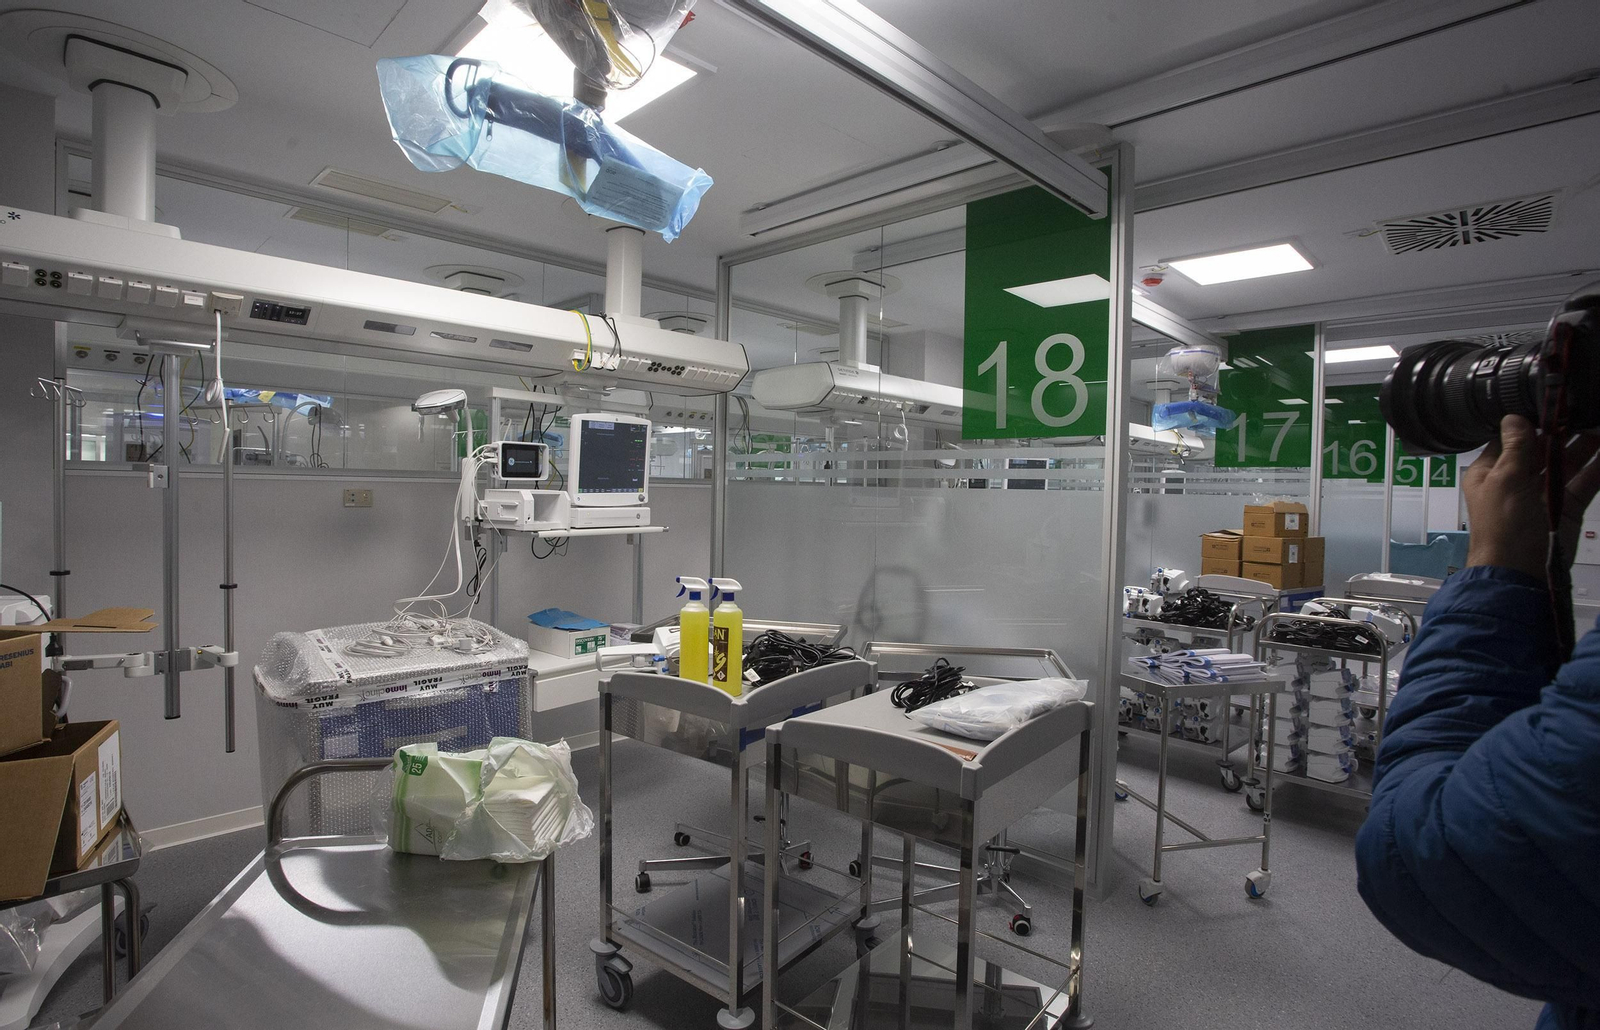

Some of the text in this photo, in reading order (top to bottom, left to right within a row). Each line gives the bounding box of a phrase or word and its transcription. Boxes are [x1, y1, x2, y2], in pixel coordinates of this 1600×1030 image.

[977, 333, 1089, 429] 18
[1226, 411, 1300, 462] 17
[1323, 439, 1377, 476] 16
[413, 676, 443, 686] FRAGIL
[420, 684, 438, 692] MUY
[305, 693, 340, 704] FRAGIL
[312, 701, 334, 710] MUY
[412, 762, 422, 774] 25
